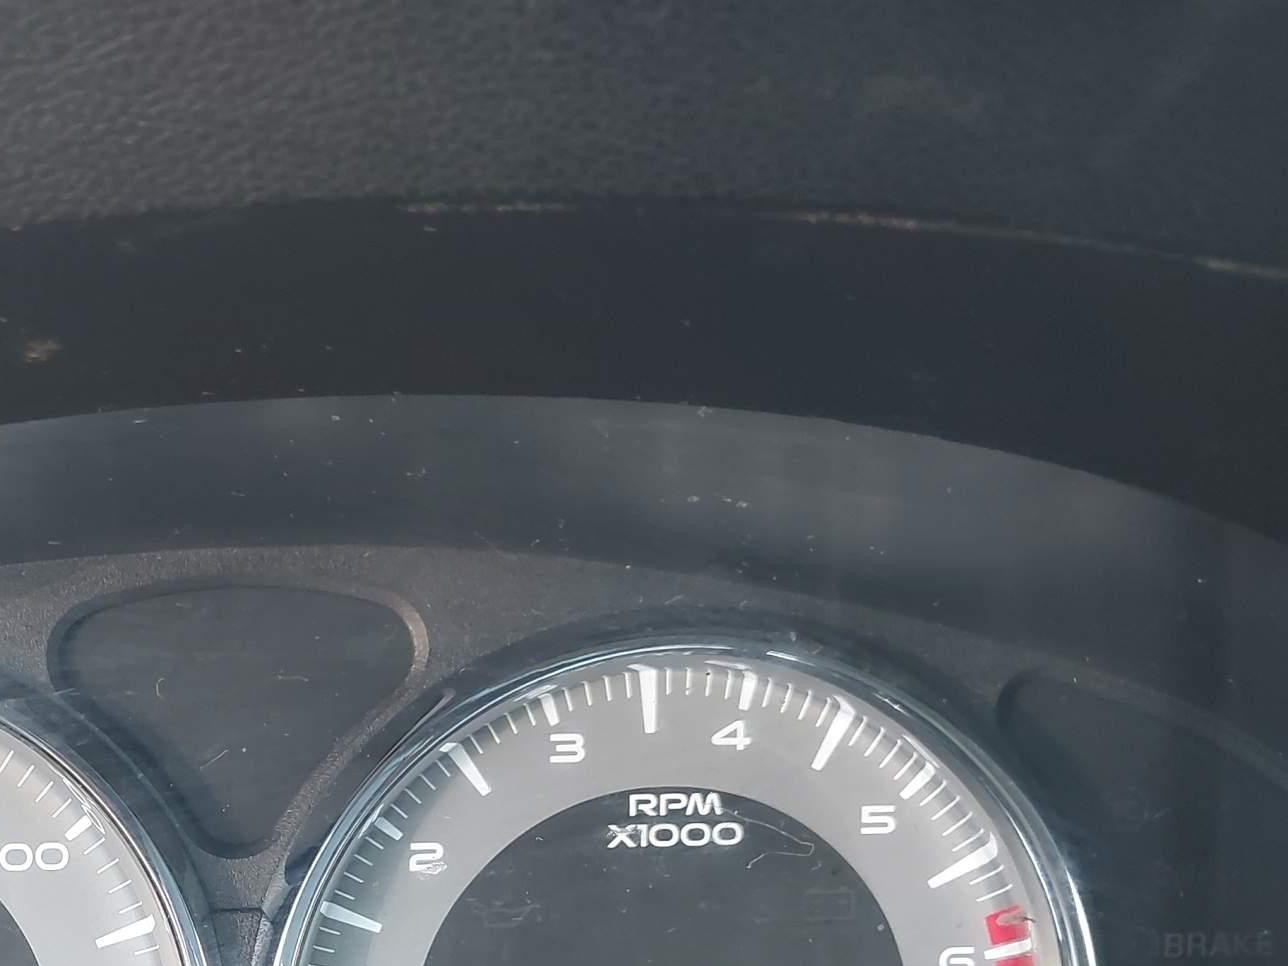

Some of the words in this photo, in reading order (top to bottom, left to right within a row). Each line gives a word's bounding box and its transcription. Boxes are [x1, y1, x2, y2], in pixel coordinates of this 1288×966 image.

[550, 734, 586, 763] 3
[712, 721, 752, 752] 4
[629, 793, 723, 816] RPM
[860, 806, 897, 836] 5
[409, 843, 446, 875] 2
[1164, 932, 1272, 958] BRAKE
